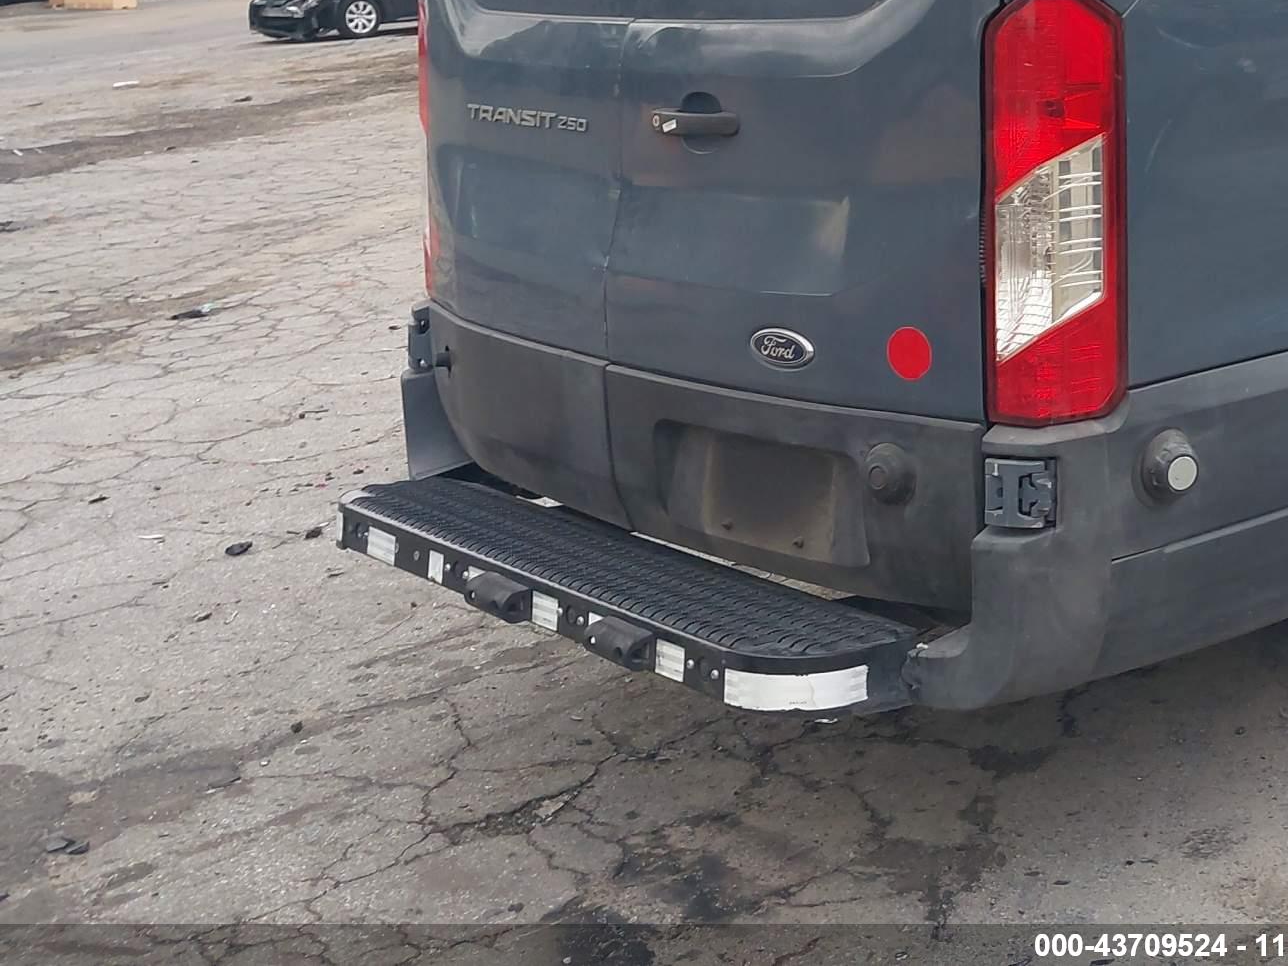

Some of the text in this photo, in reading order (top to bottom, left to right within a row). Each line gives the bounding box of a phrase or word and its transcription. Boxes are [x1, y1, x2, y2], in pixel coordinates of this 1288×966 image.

[467, 103, 587, 132] TRANSIT 250
[761, 335, 796, 359] Ford
